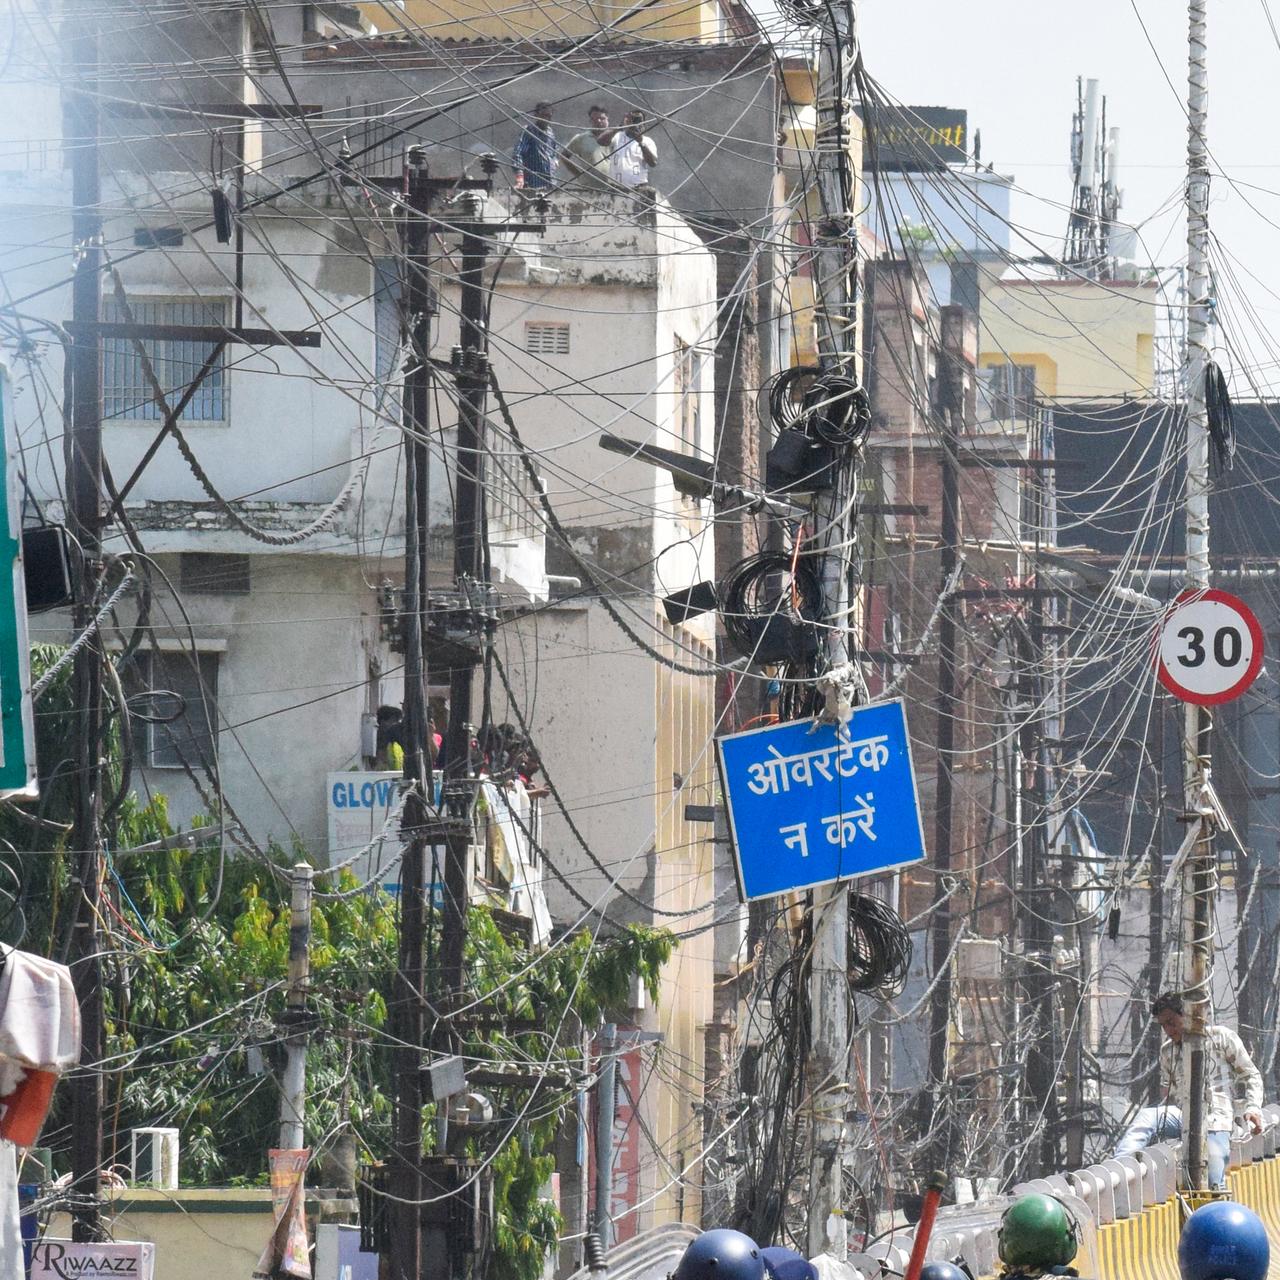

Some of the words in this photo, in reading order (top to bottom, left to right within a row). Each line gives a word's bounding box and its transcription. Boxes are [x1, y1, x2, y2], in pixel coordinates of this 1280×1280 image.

[1176, 624, 1242, 667] 30
[747, 733, 889, 796] ओवरटेक
[779, 824, 809, 859] न
[821, 792, 879, 850] करें
